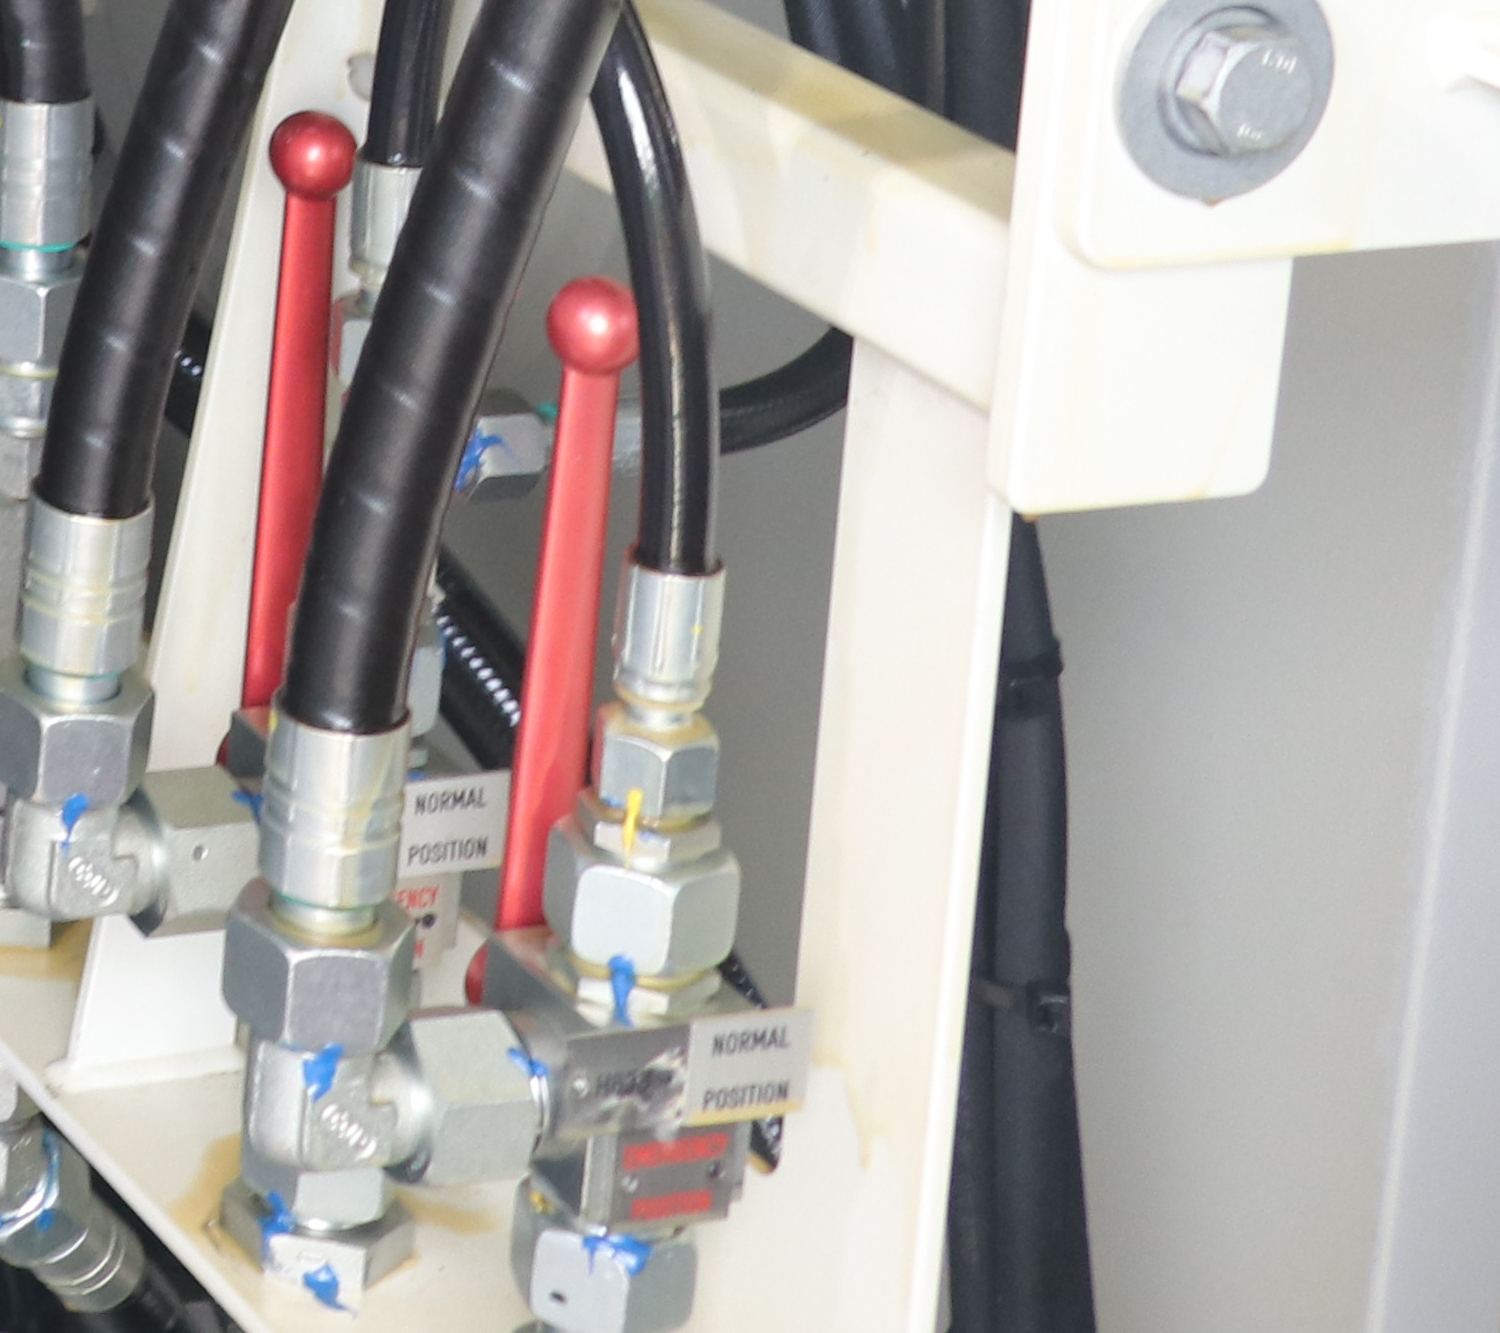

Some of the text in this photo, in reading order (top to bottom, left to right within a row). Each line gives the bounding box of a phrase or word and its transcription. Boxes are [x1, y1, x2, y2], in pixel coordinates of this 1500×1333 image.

[415, 786, 486, 815] NORMAL
[408, 837, 488, 866] POSITION
[712, 1025, 790, 1056] NORMAL
[702, 1081, 790, 1112] POSITION
